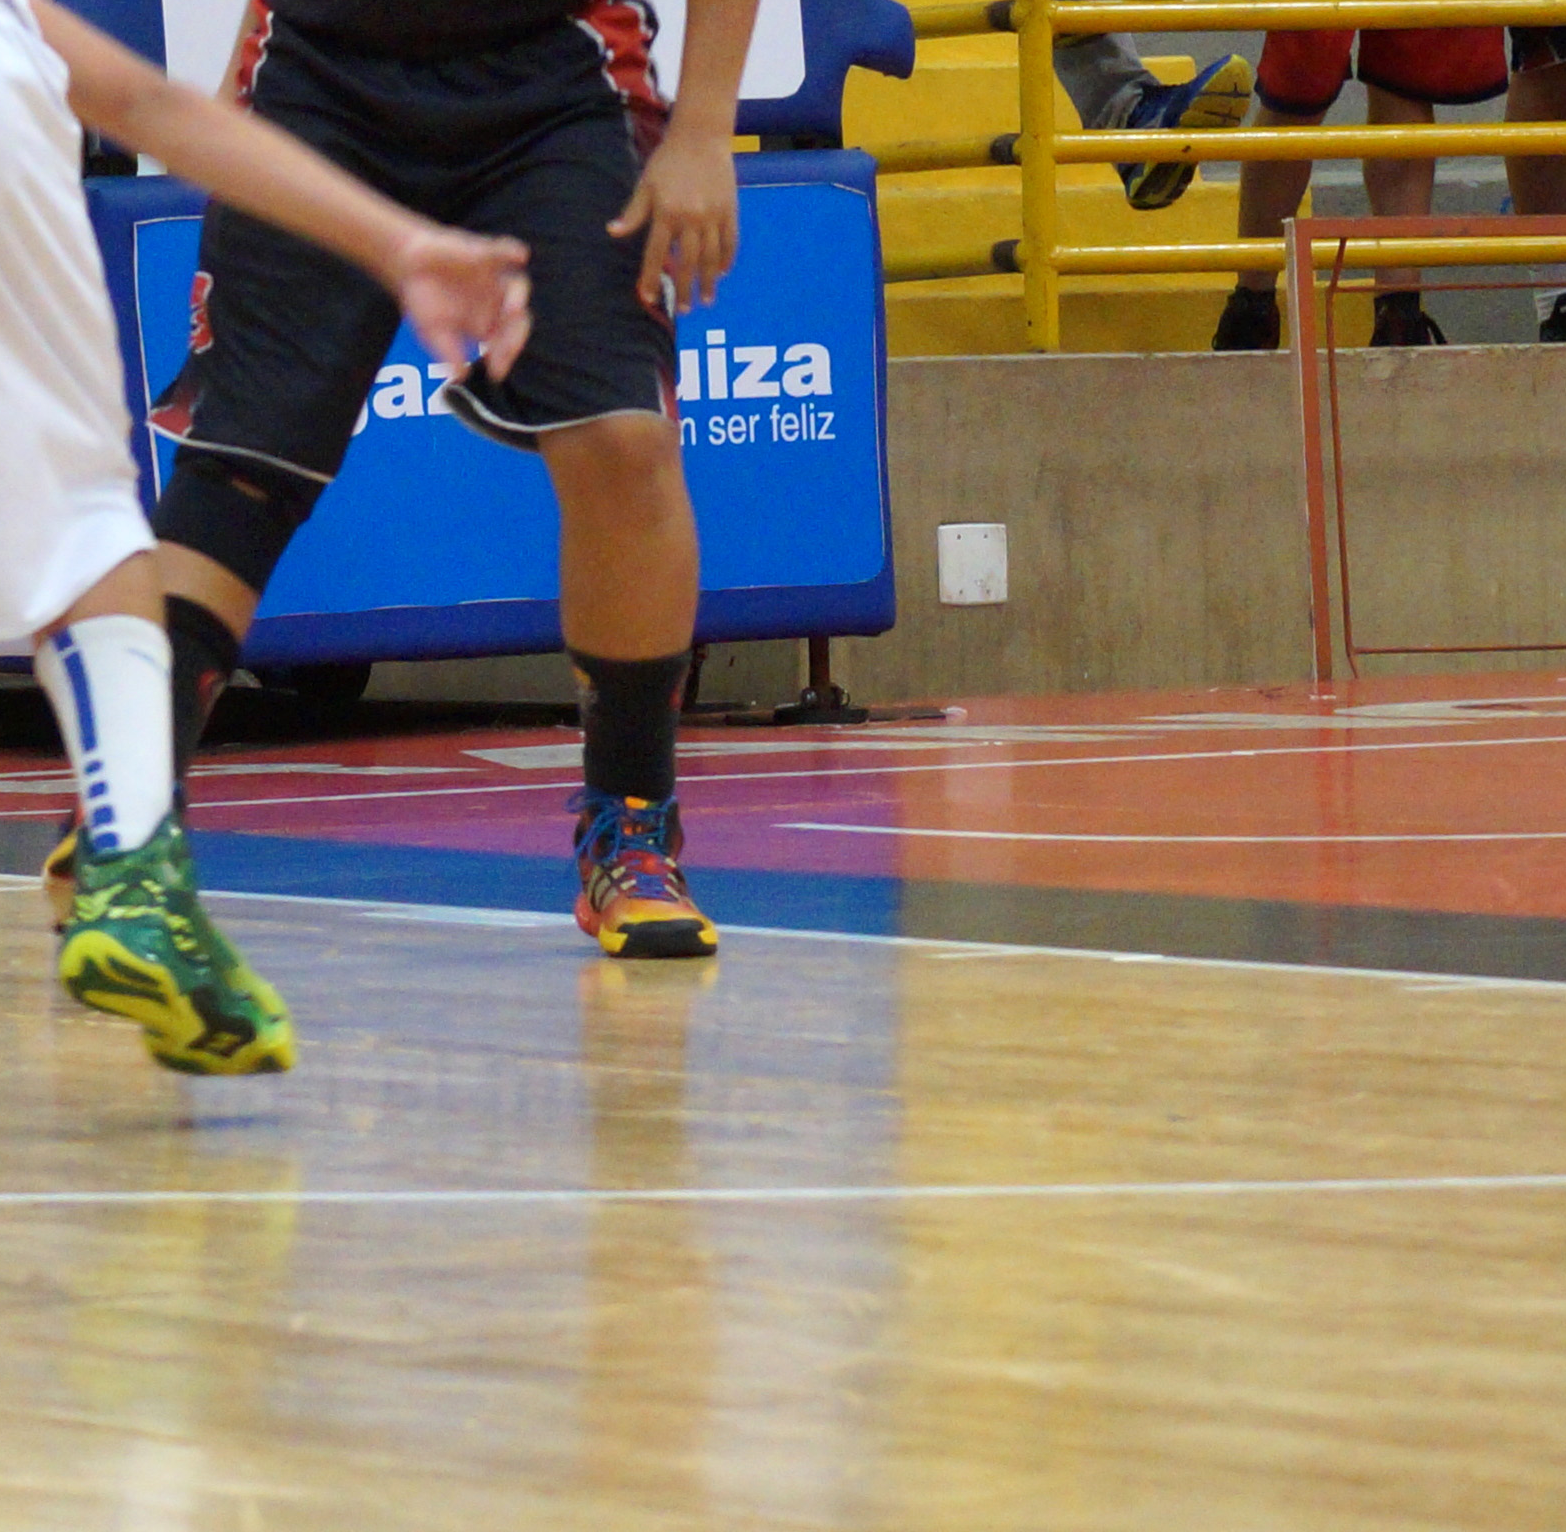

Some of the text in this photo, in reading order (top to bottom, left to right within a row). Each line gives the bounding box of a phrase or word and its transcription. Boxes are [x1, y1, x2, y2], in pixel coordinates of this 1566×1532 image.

[676, 328, 832, 400] uiza
[707, 418, 758, 445] ser
[769, 403, 837, 444] feliz
